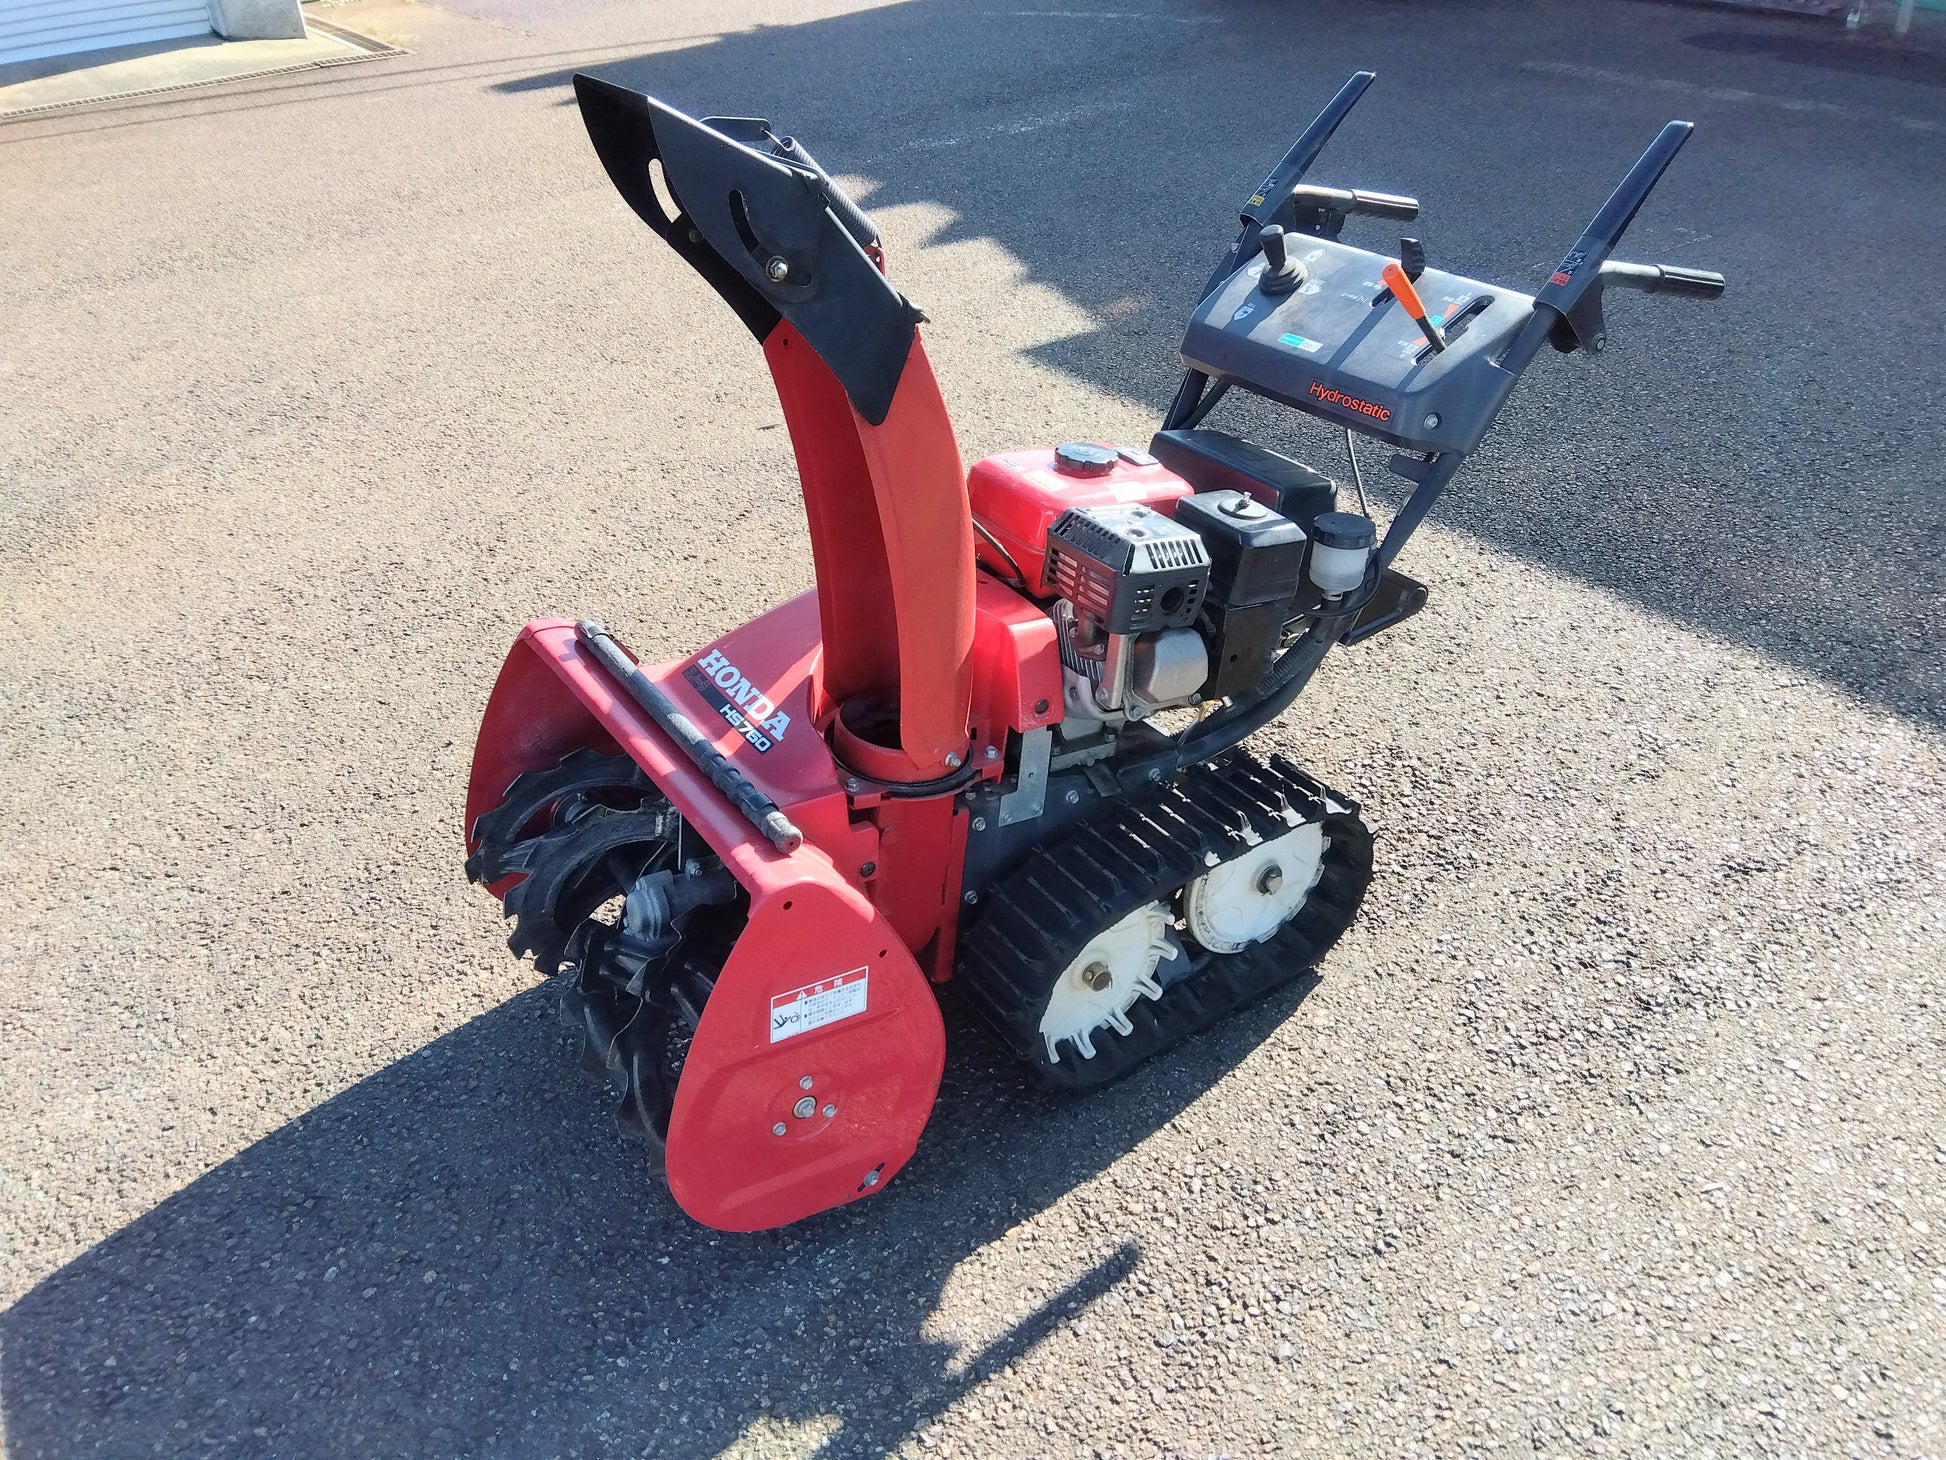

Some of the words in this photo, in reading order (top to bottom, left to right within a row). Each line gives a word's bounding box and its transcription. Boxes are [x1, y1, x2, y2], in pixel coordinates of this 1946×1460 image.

[1309, 381, 1391, 421] Hydrostatic
[697, 648, 791, 742] HONDA
[719, 703, 772, 752] HS760
